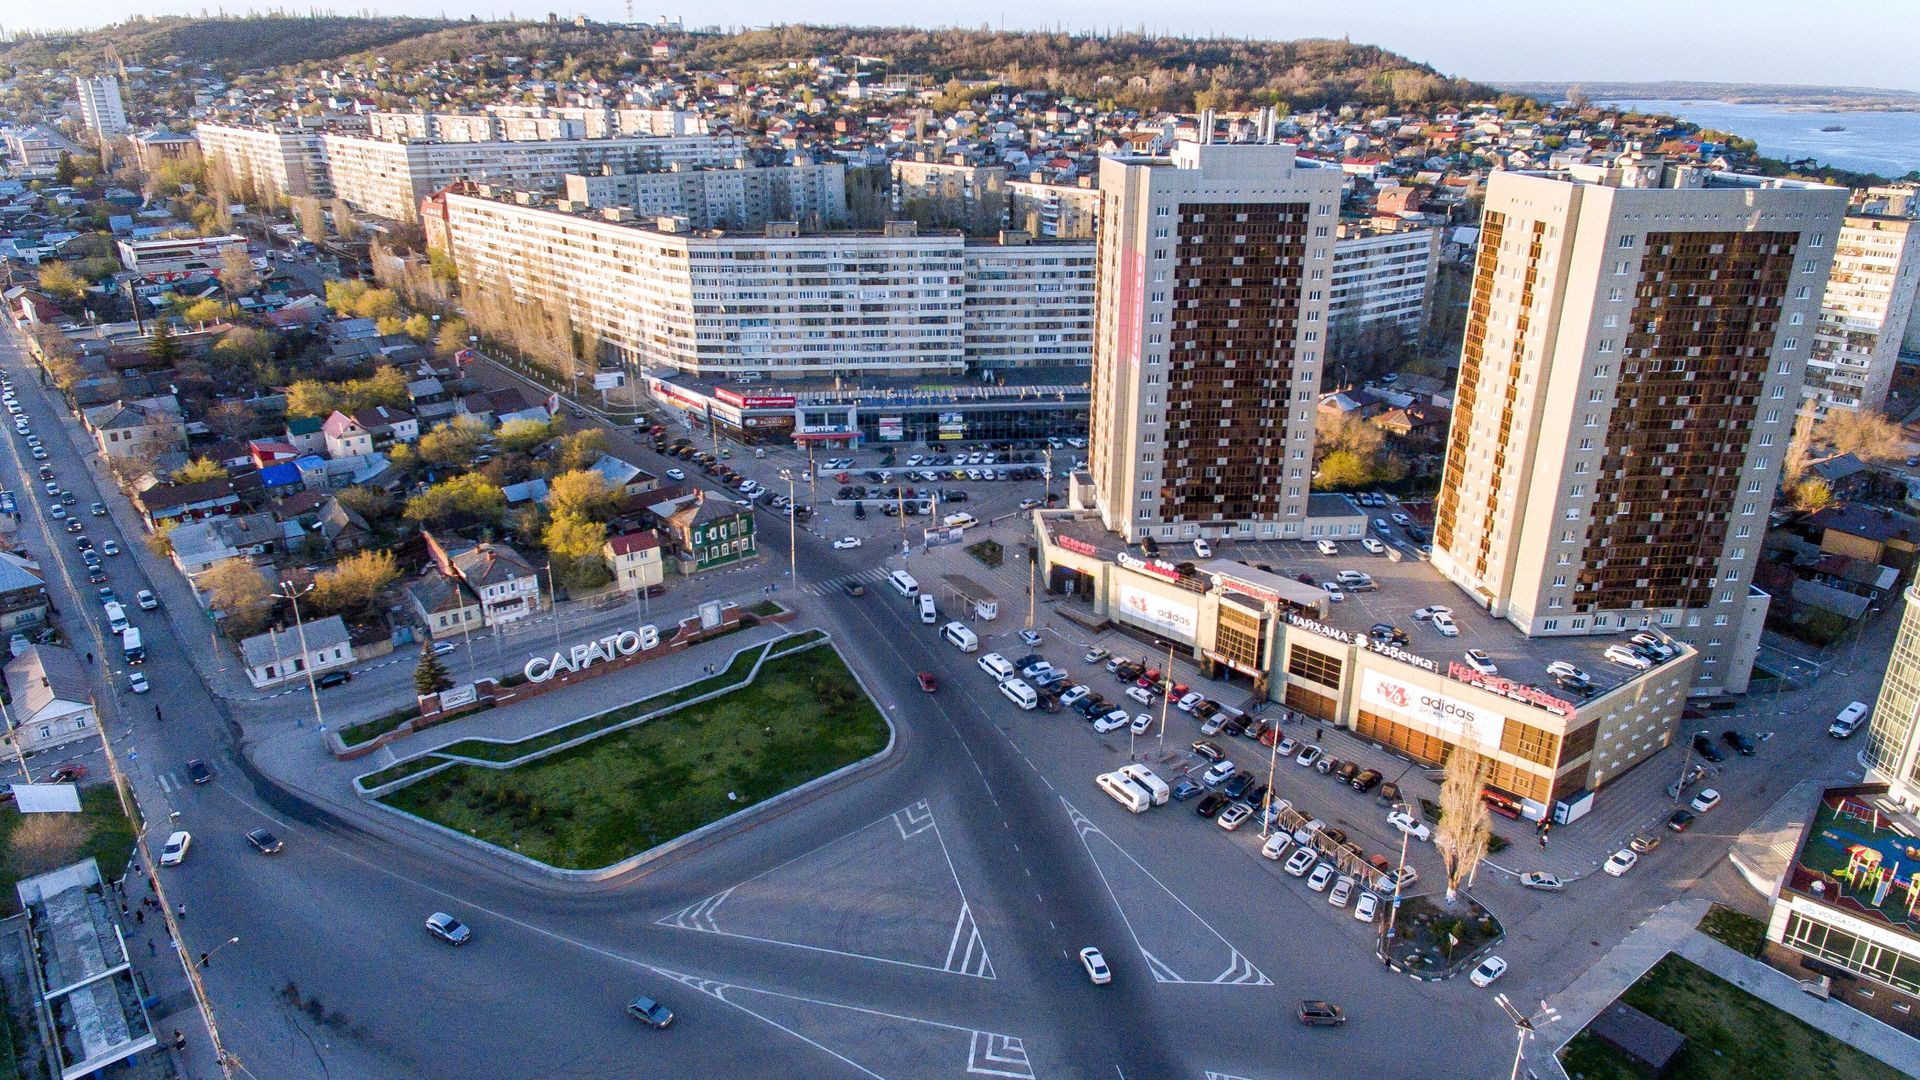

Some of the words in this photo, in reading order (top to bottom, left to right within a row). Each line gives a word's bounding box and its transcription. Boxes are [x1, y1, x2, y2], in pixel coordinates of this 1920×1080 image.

[1157, 608, 1190, 626] adidas
[1288, 613, 1349, 643] ЧАЙХАНА
[524, 624, 660, 683] САРАТОВ
[1420, 695, 1476, 722] adidas
